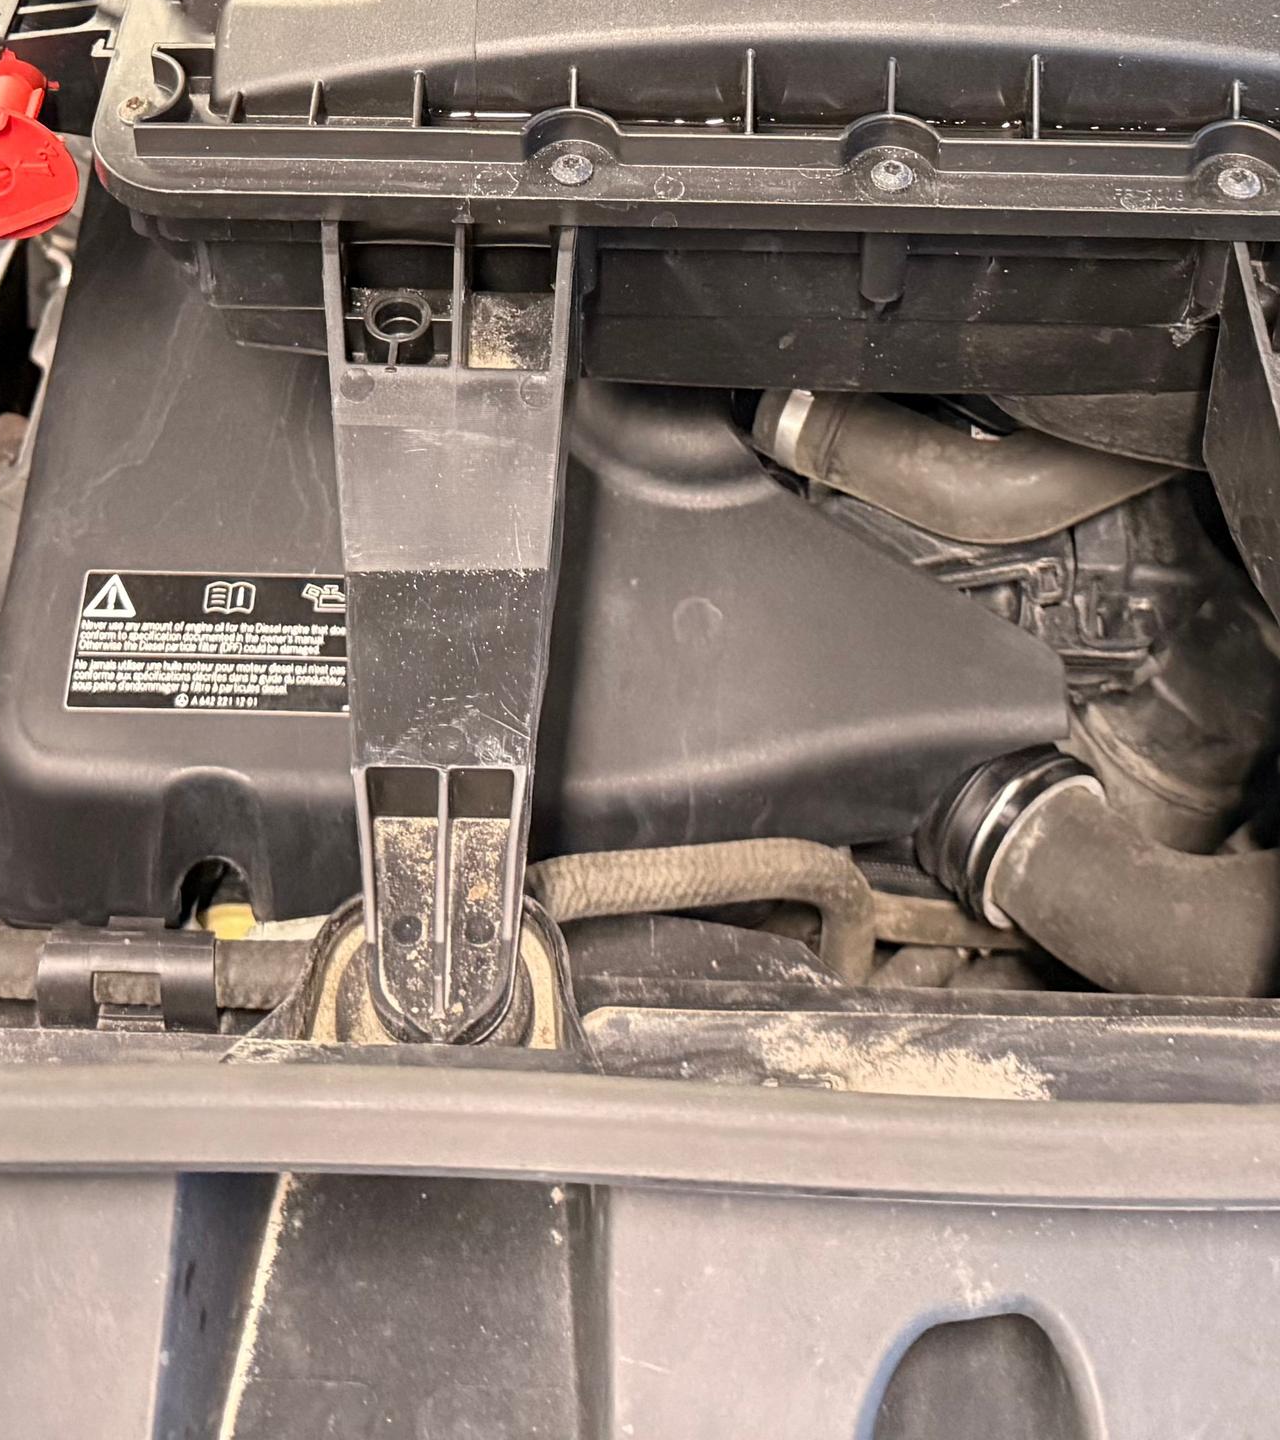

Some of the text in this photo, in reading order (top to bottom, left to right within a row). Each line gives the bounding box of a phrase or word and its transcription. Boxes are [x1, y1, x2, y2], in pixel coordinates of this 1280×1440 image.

[81, 620, 107, 630] Never
[108, 621, 124, 630] use
[125, 621, 140, 632] any
[141, 620, 173, 632] amount
[185, 621, 213, 634] engine
[256, 623, 281, 634] Diesel
[282, 624, 309, 636] engine
[311, 624, 328, 635] that
[329, 625, 347, 636] doe
[80, 630, 116, 640] conform
[129, 631, 181, 643] specification
[182, 632, 235, 643] documented
[260, 634, 293, 645] owner's
[79, 640, 122, 651] Otherwise
[123, 641, 138, 651] the
[139, 641, 165, 652] Diesel
[165, 642, 197, 653] particle
[198, 642, 218, 653] filter
[220, 642, 242, 654] (DPF)
[243, 644, 266, 654] could
[89, 659, 117, 671] jamais
[118, 659, 145, 670] utiliser
[146, 661, 162, 671] une
[163, 660, 182, 671] huile
[183, 661, 214, 672] moteur
[215, 663, 235, 674] pour
[236, 663, 268, 673] moteur
[269, 663, 294, 674] diesel
[329, 665, 346, 678] pas
[73, 669, 115, 680] conforme
[116, 671, 132, 680] aux
[229, 672, 249, 683] dans
[258, 673, 282, 686] guide
[72, 680, 92, 691] sous
[93, 680, 117, 693] peine
[219, 682, 260, 695] particules
[199, 695, 216, 707] 642
[217, 695, 233, 707] 221
